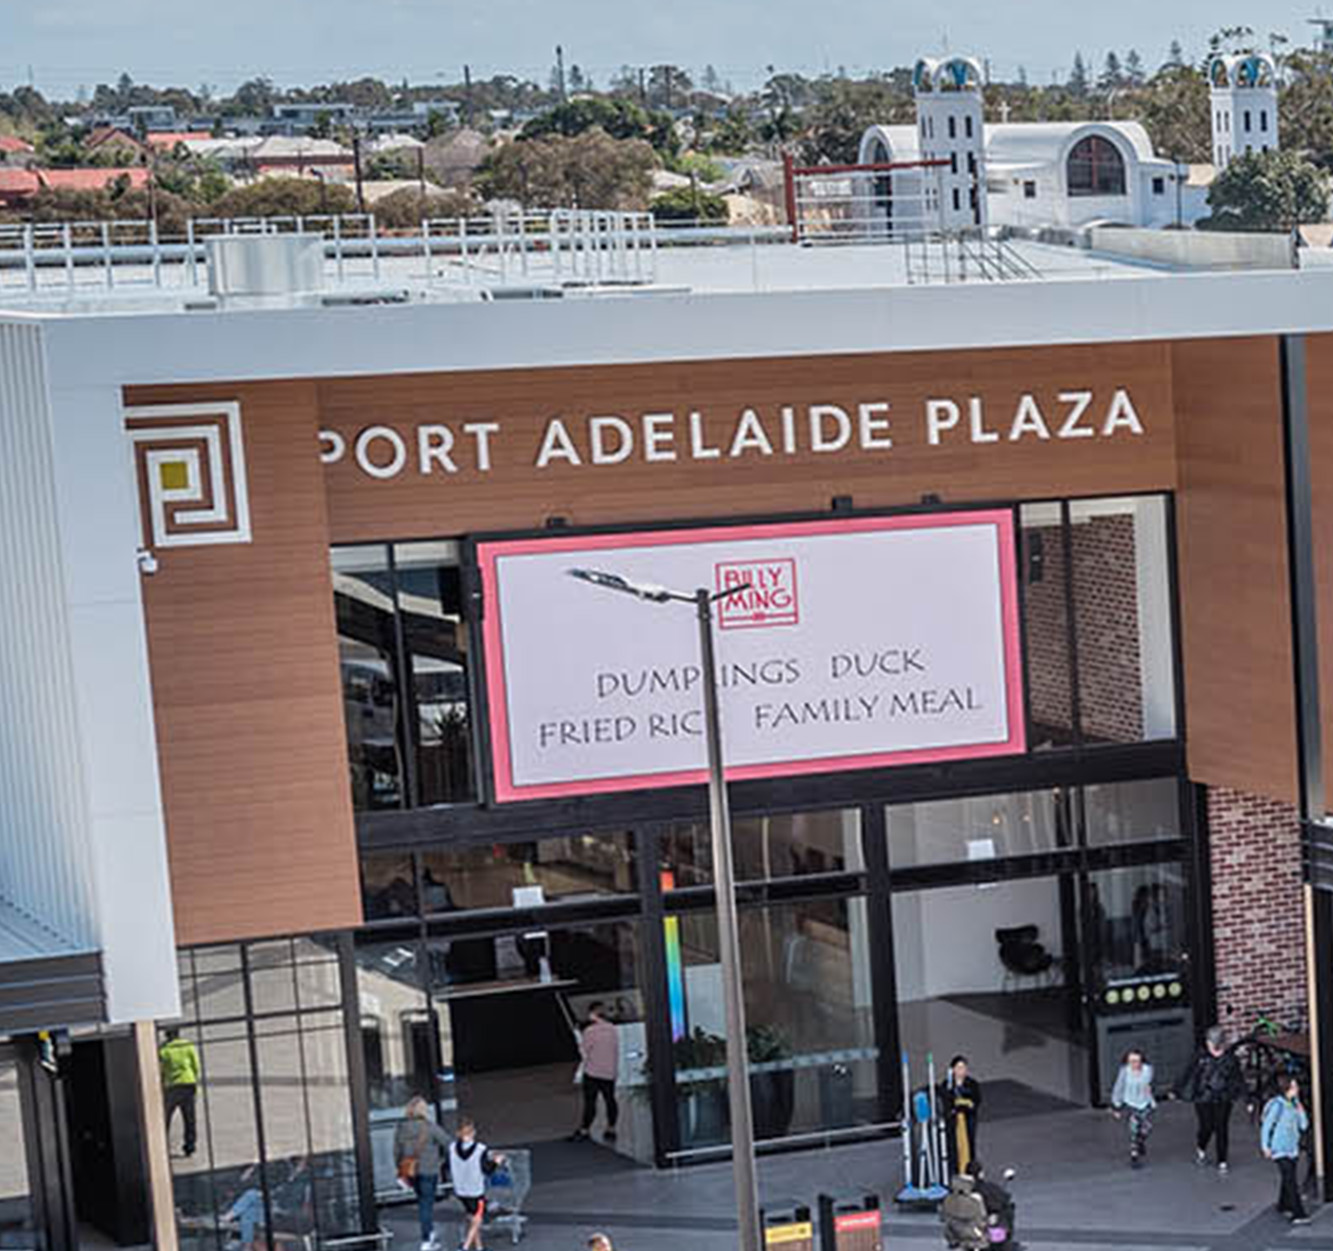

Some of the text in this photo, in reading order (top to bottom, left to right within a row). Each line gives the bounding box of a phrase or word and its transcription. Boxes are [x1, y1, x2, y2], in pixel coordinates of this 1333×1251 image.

[535, 402, 893, 467] ADELAIDE
[925, 388, 1145, 445] PLAZA
[724, 567, 782, 590] BILLY
[725, 587, 792, 612] MING
[597, 648, 926, 698] DUMPINGS DUCK
[538, 686, 983, 748] FRIED RIC FAMILY MEAL
